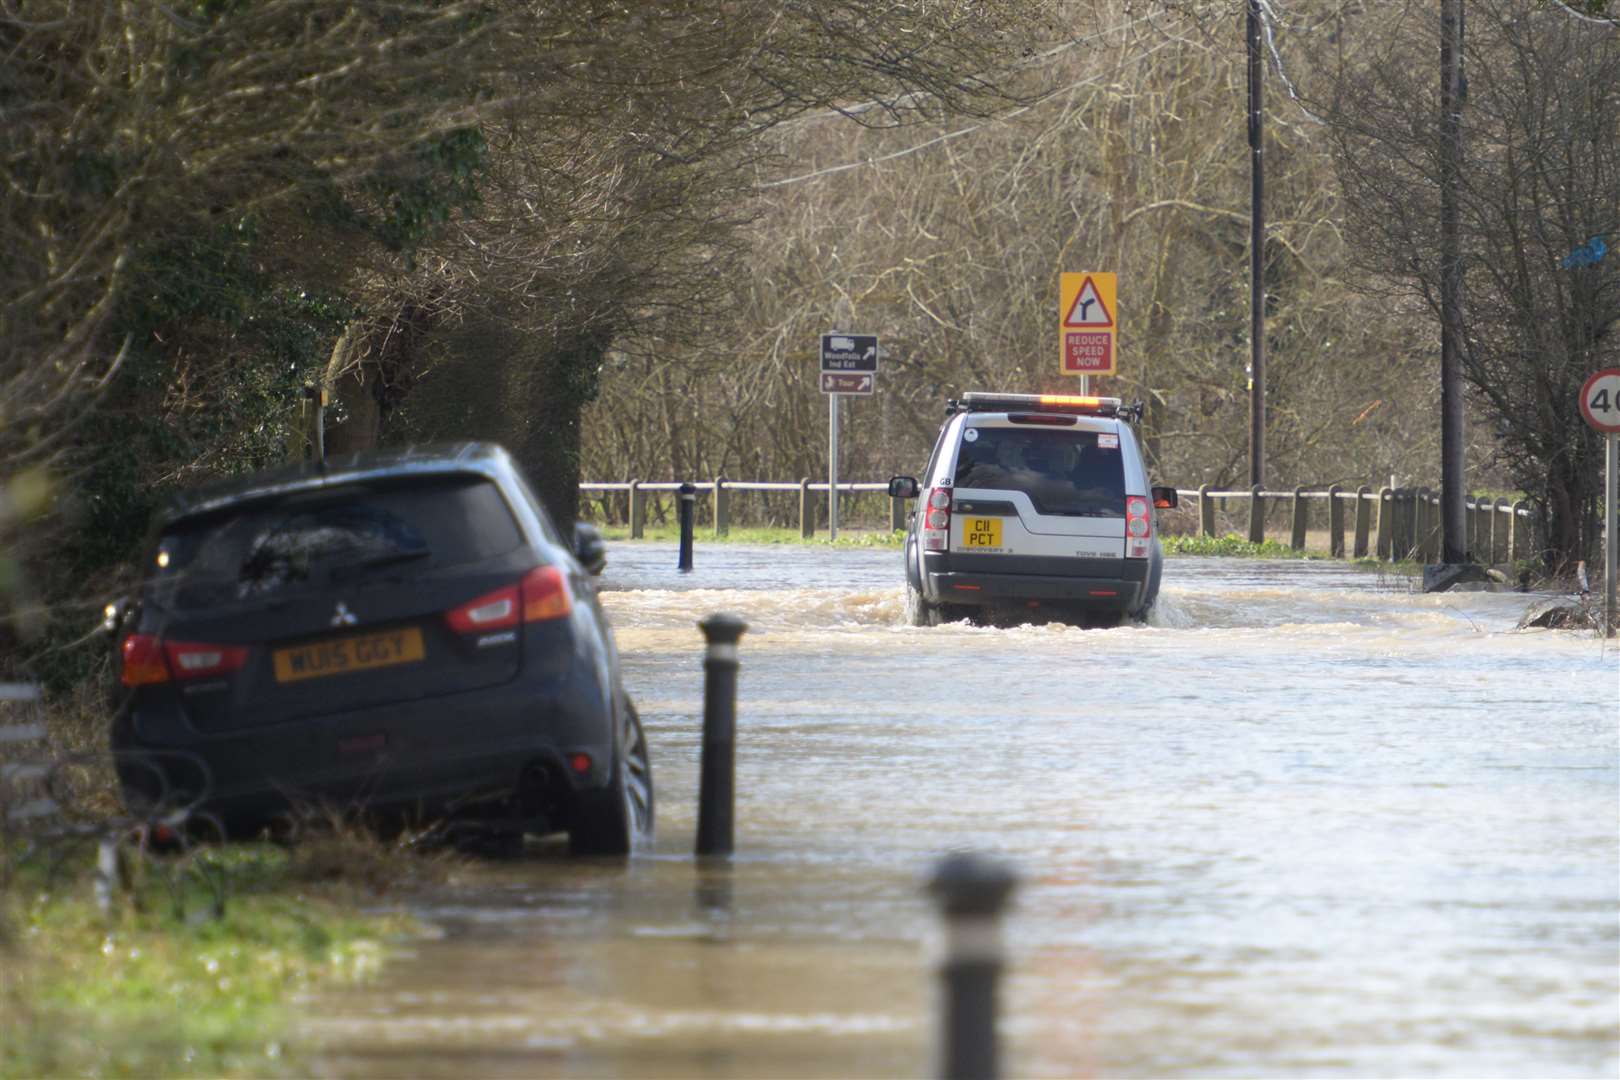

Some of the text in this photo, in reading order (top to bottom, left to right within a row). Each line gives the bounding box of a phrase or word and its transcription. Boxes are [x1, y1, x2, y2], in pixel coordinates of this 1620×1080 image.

[1068, 335, 1109, 345] REDUCE
[1071, 346, 1105, 356] SPEED
[1076, 357, 1101, 367] NOW
[1590, 388, 1620, 413] 4
[940, 478, 951, 486] GB
[969, 533, 994, 545] PCT
